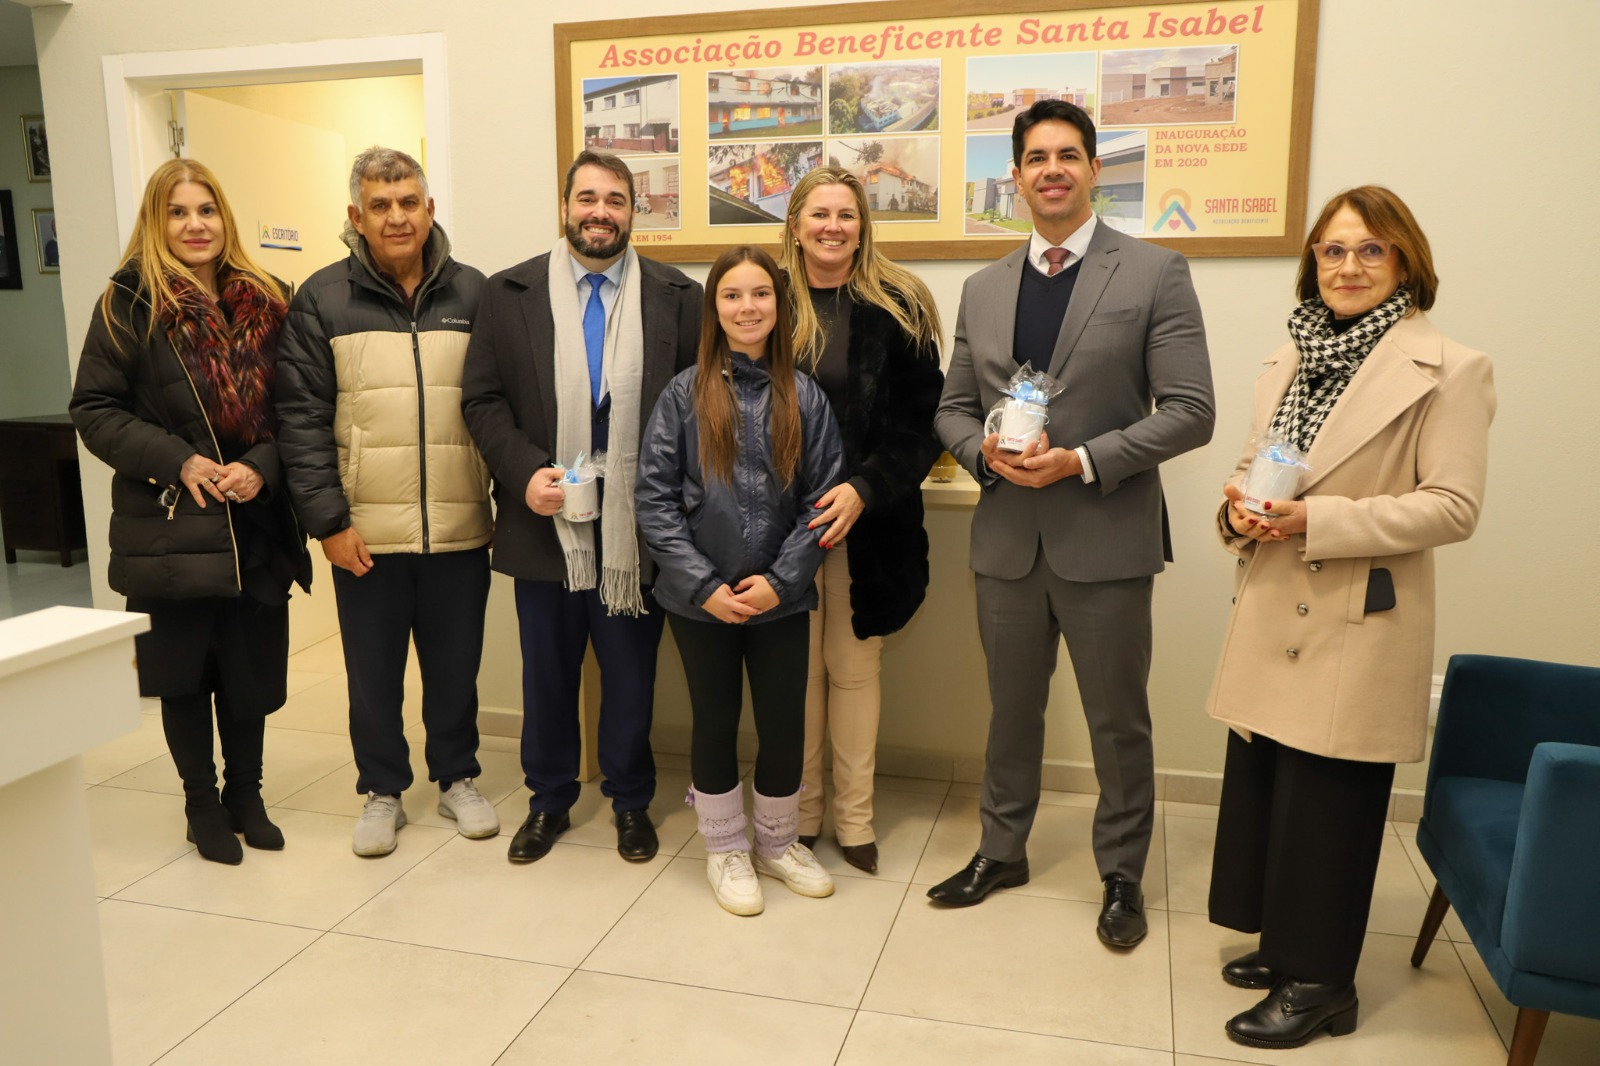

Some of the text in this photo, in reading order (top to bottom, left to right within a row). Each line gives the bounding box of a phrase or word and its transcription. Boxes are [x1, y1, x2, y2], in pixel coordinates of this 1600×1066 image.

[598, 5, 1264, 68] Associação Beneficente Santa Isabel
[1155, 127, 1247, 141] INAUGURAÇÃO
[1155, 142, 1248, 154] DA NOVA SEDE
[1155, 157, 1208, 168] EM 2020
[1204, 197, 1278, 214] SANTA ISABEL
[272, 227, 299, 241] ESCRITÓRIO
[636, 234, 649, 242] EM
[652, 234, 672, 242] 1954
[447, 317, 470, 325] Columbia
